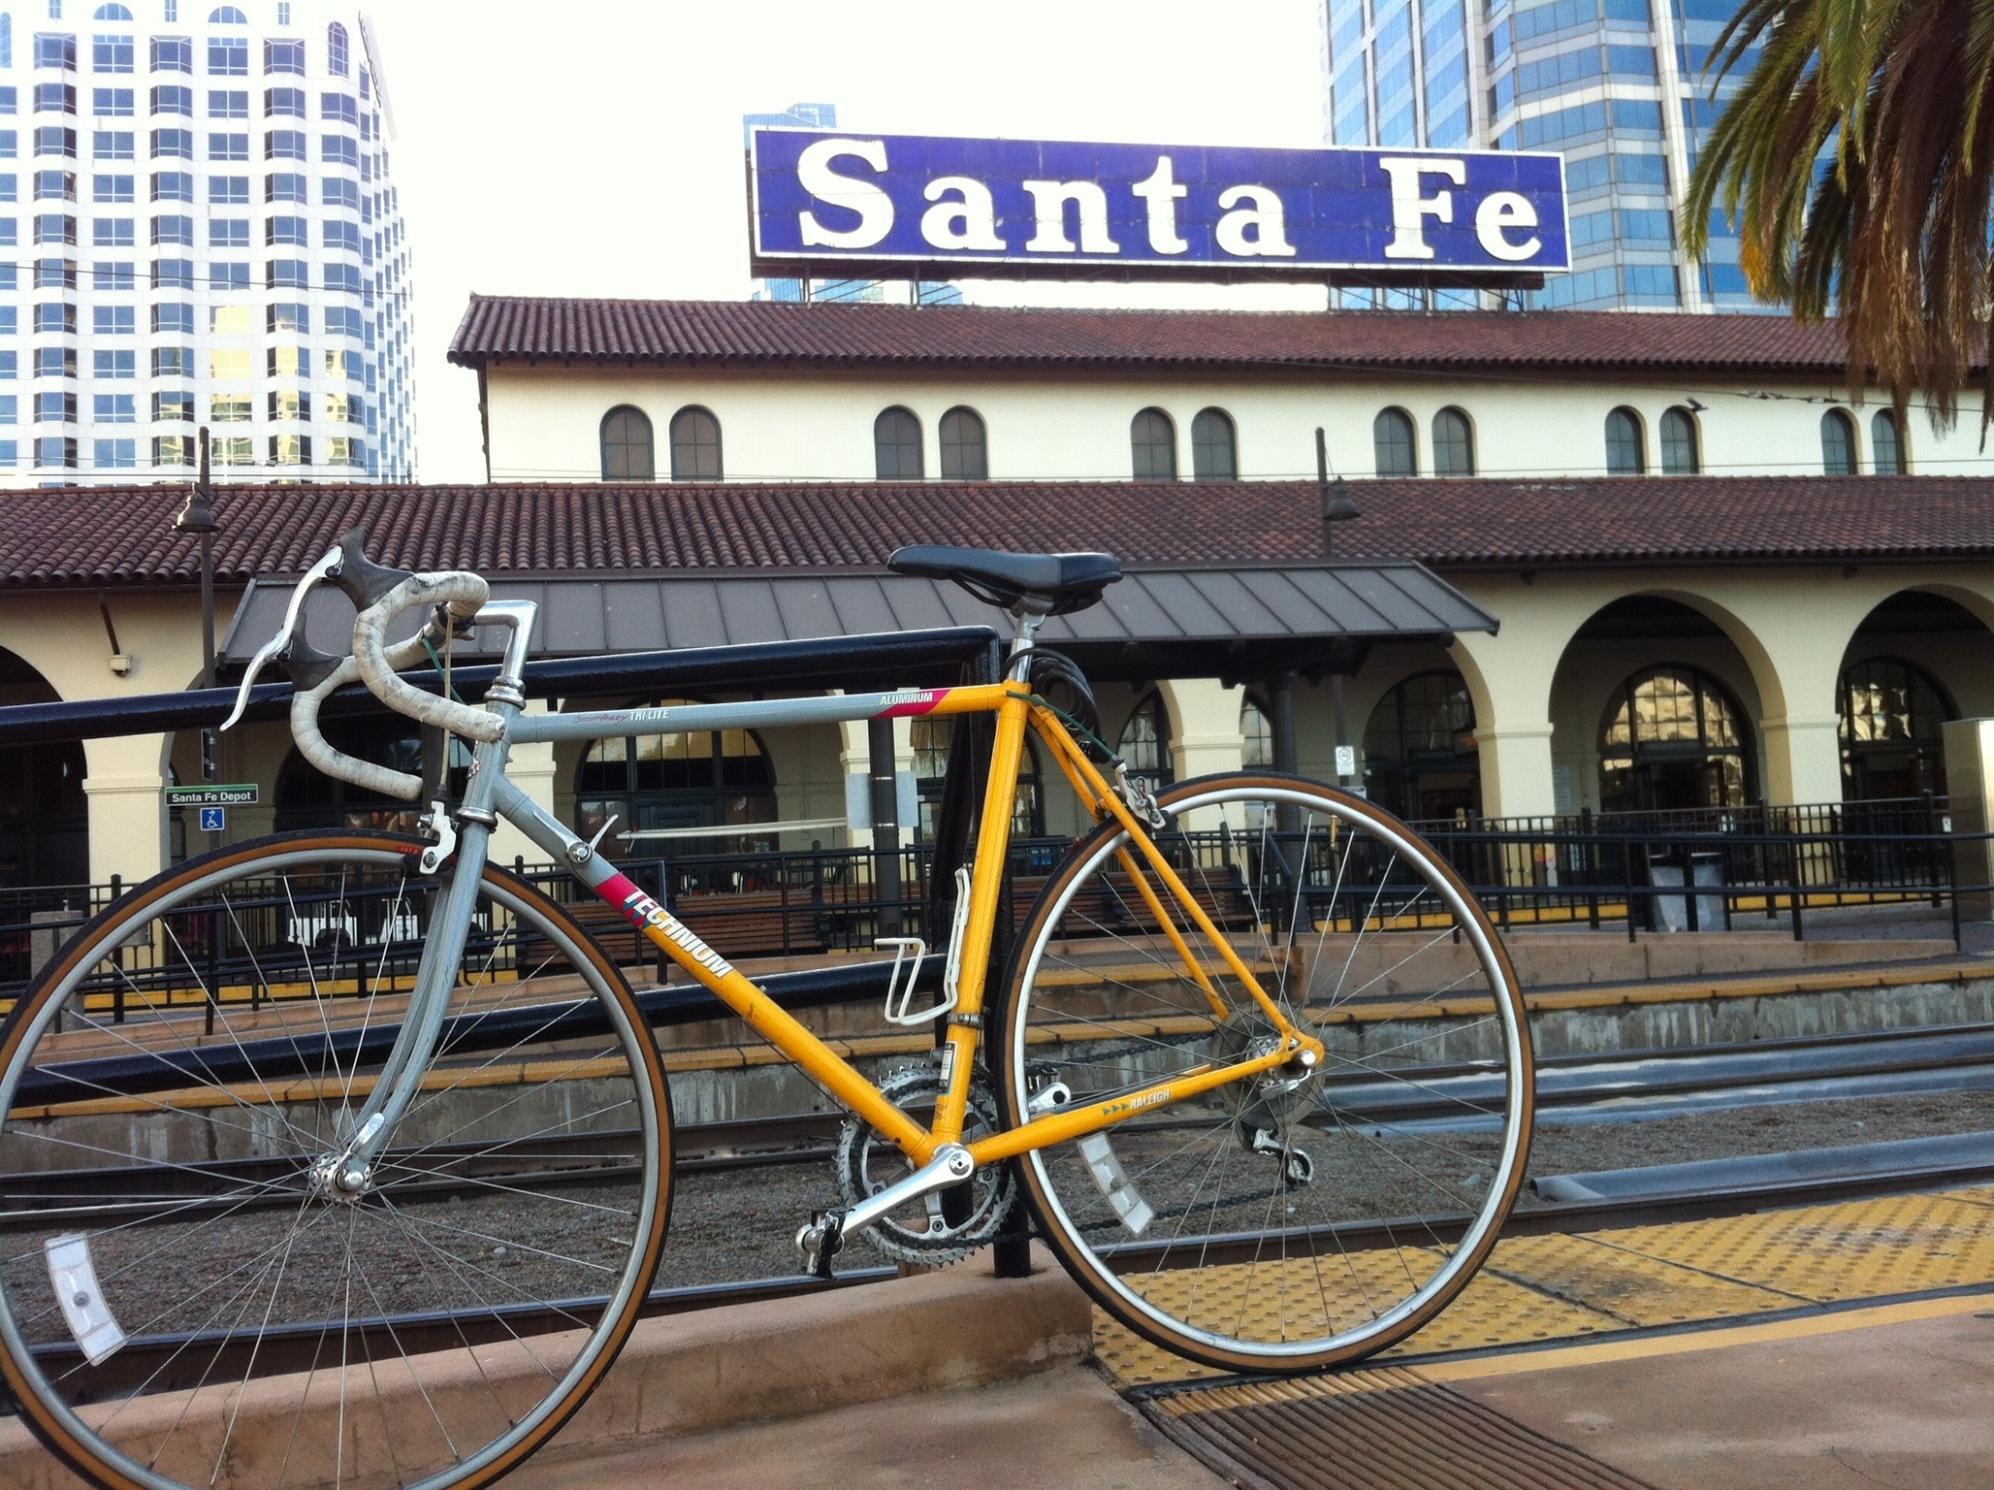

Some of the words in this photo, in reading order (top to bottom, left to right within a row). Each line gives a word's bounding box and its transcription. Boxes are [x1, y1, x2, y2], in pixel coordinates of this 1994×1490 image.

[797, 138, 1297, 257] Santa
[1379, 156, 1543, 261] Fe
[880, 691, 933, 705] ALUMINUM
[172, 792, 202, 803] Santa
[205, 792, 217, 801] Fe
[220, 791, 251, 802] Depot
[624, 887, 734, 978] TECHNIUM
[1130, 1090, 1171, 1109] RALEIGH
